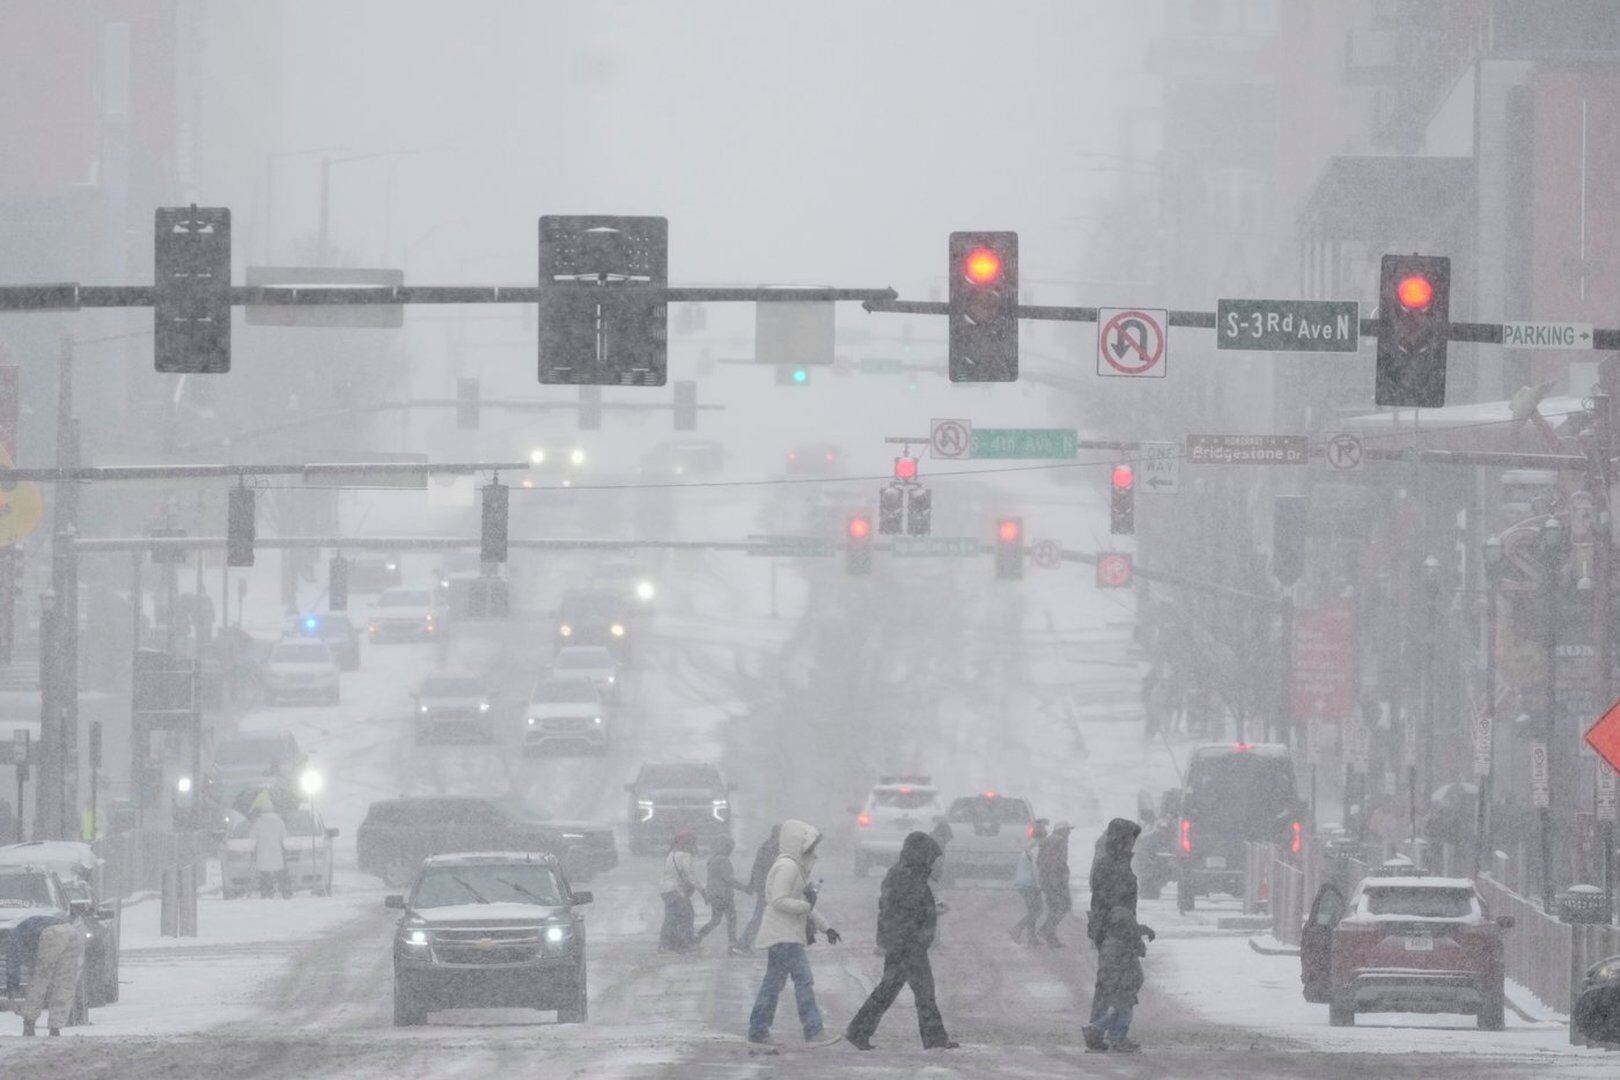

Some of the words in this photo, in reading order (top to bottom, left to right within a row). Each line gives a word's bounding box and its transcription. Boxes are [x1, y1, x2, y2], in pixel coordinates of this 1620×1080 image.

[1227, 312, 1293, 338] S-3Rd
[1297, 320, 1332, 339] Ave
[1337, 315, 1349, 340] N
[1504, 325, 1575, 346] PARKING
[1148, 447, 1174, 459] ONE
[1193, 446, 1284, 462] Bridgestone
[1287, 450, 1303, 460] Dr
[1147, 461, 1174, 473] WAY
